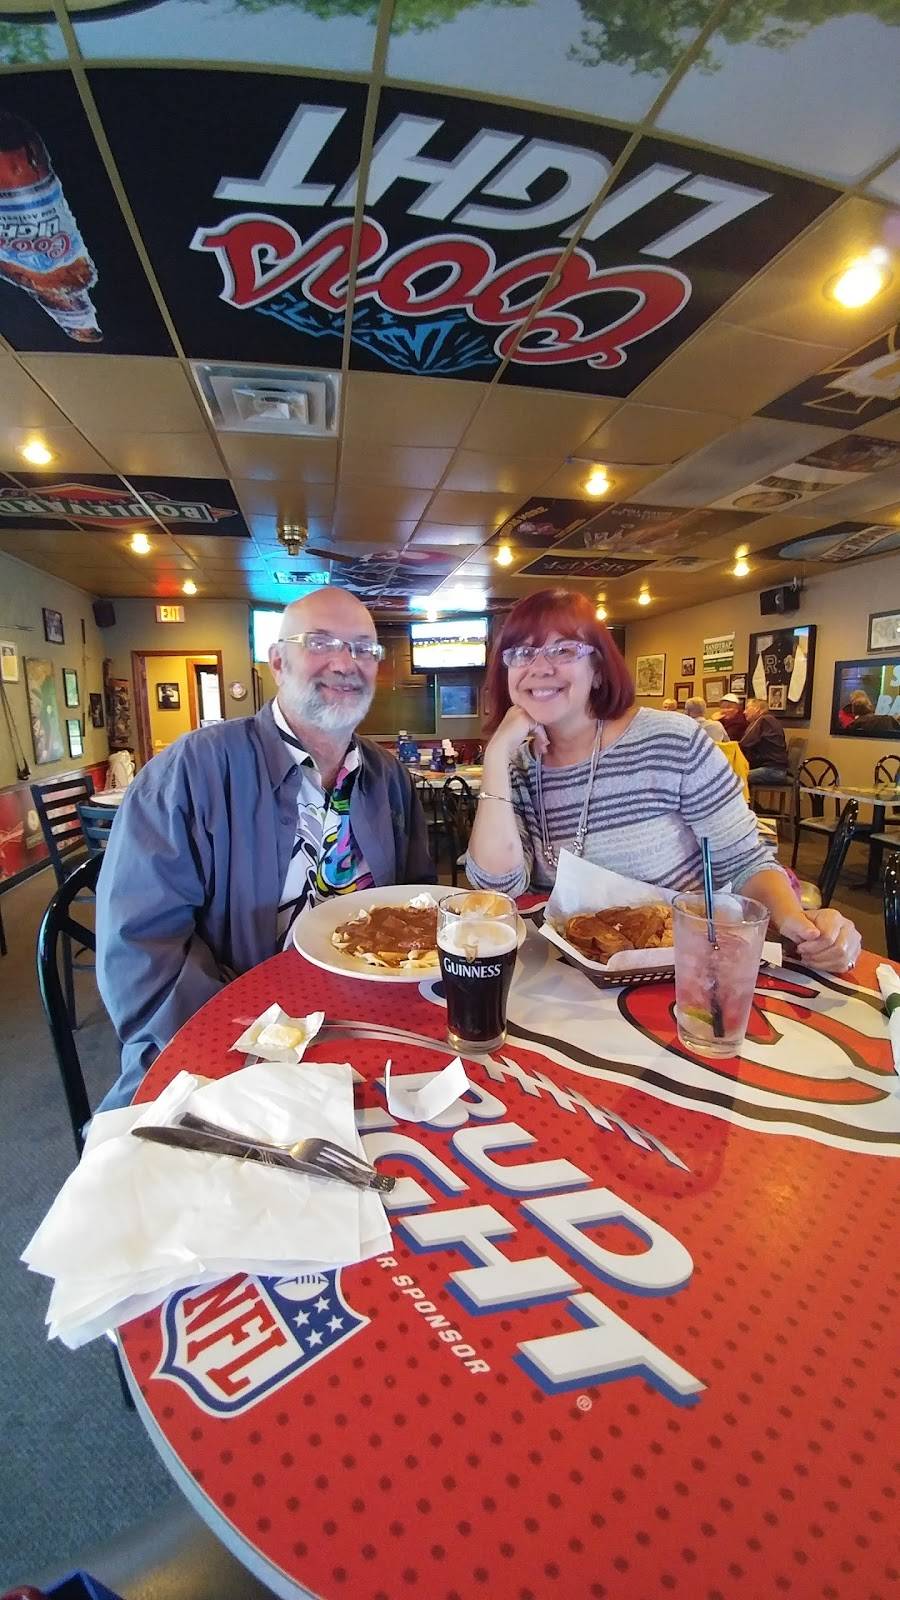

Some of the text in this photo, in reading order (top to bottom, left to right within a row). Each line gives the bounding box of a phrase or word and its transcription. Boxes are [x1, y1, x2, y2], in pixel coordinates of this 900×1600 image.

[213, 103, 774, 259] LIGHT
[443, 956, 502, 978] GUINNESS
[373, 1070, 694, 1298] BUD
[350, 1106, 708, 1407] GHT
[391, 1274, 491, 1374] SPONSOR
[182, 1271, 288, 1397] NFL
